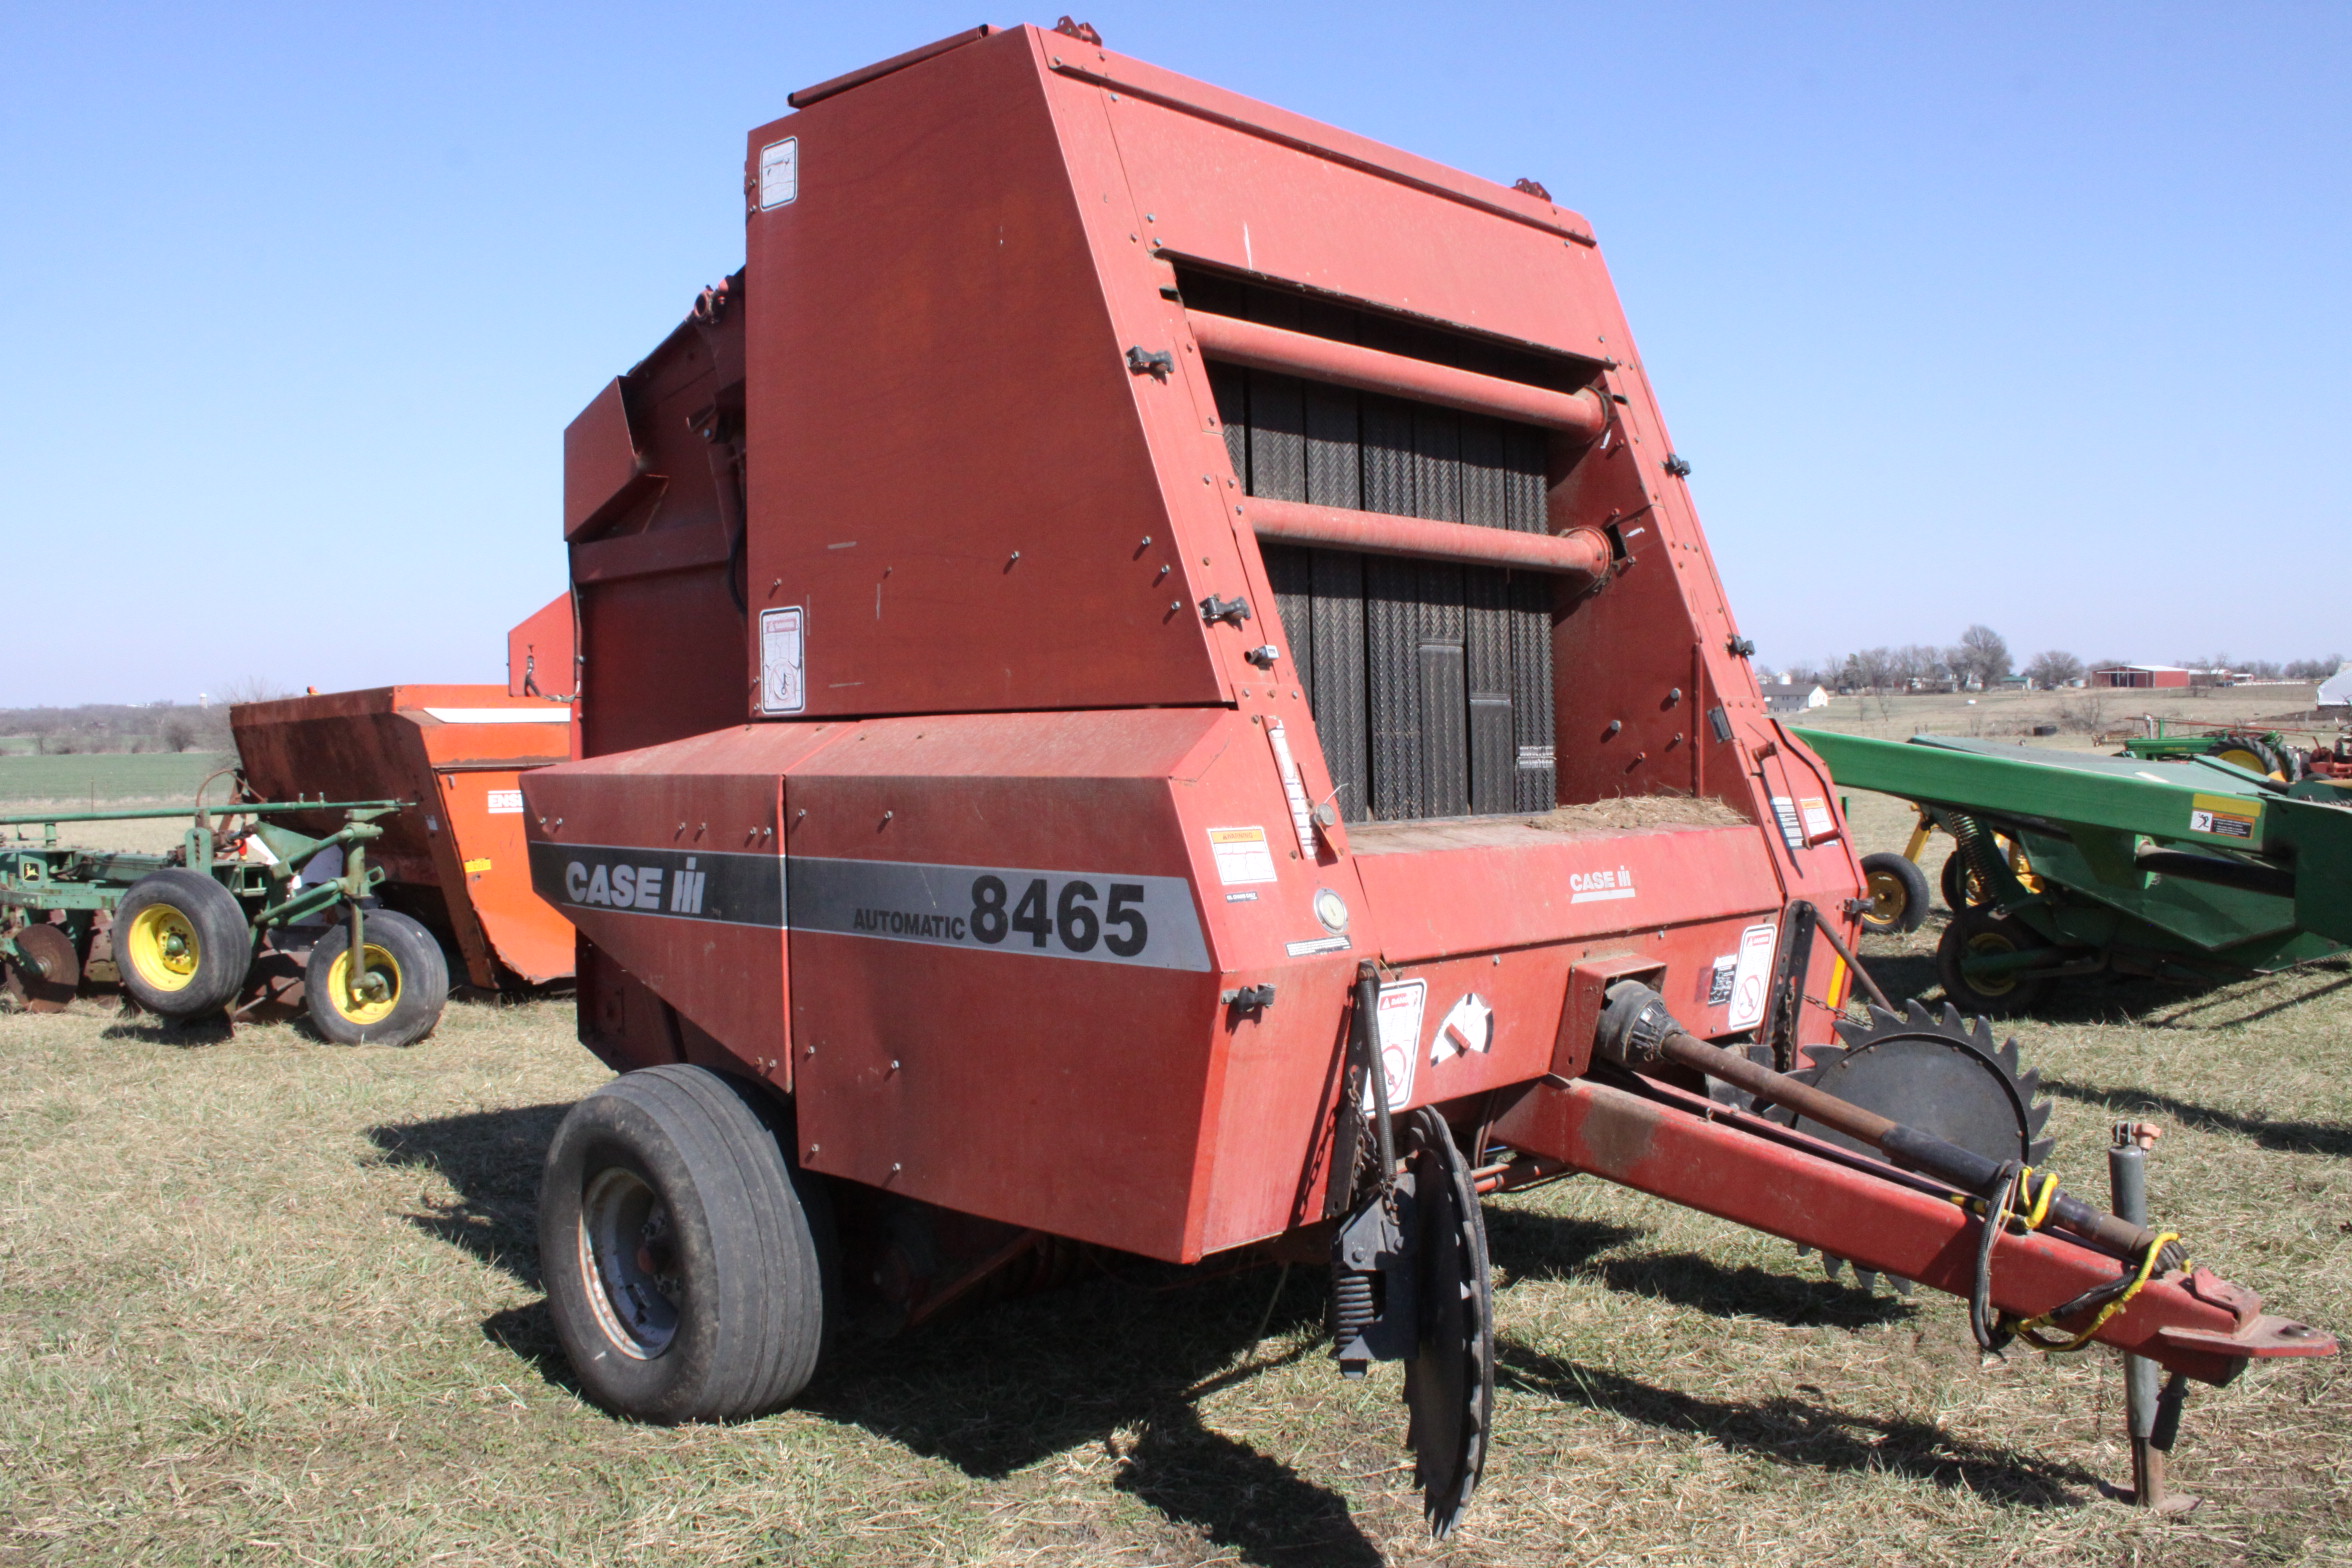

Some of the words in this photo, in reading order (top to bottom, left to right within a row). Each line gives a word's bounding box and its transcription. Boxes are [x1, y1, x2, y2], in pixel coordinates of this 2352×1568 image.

[565, 861, 663, 910] CASE
[1569, 871, 1616, 892] CASE
[853, 907, 965, 940] AUTOMATIC
[970, 874, 1148, 958] 8465
